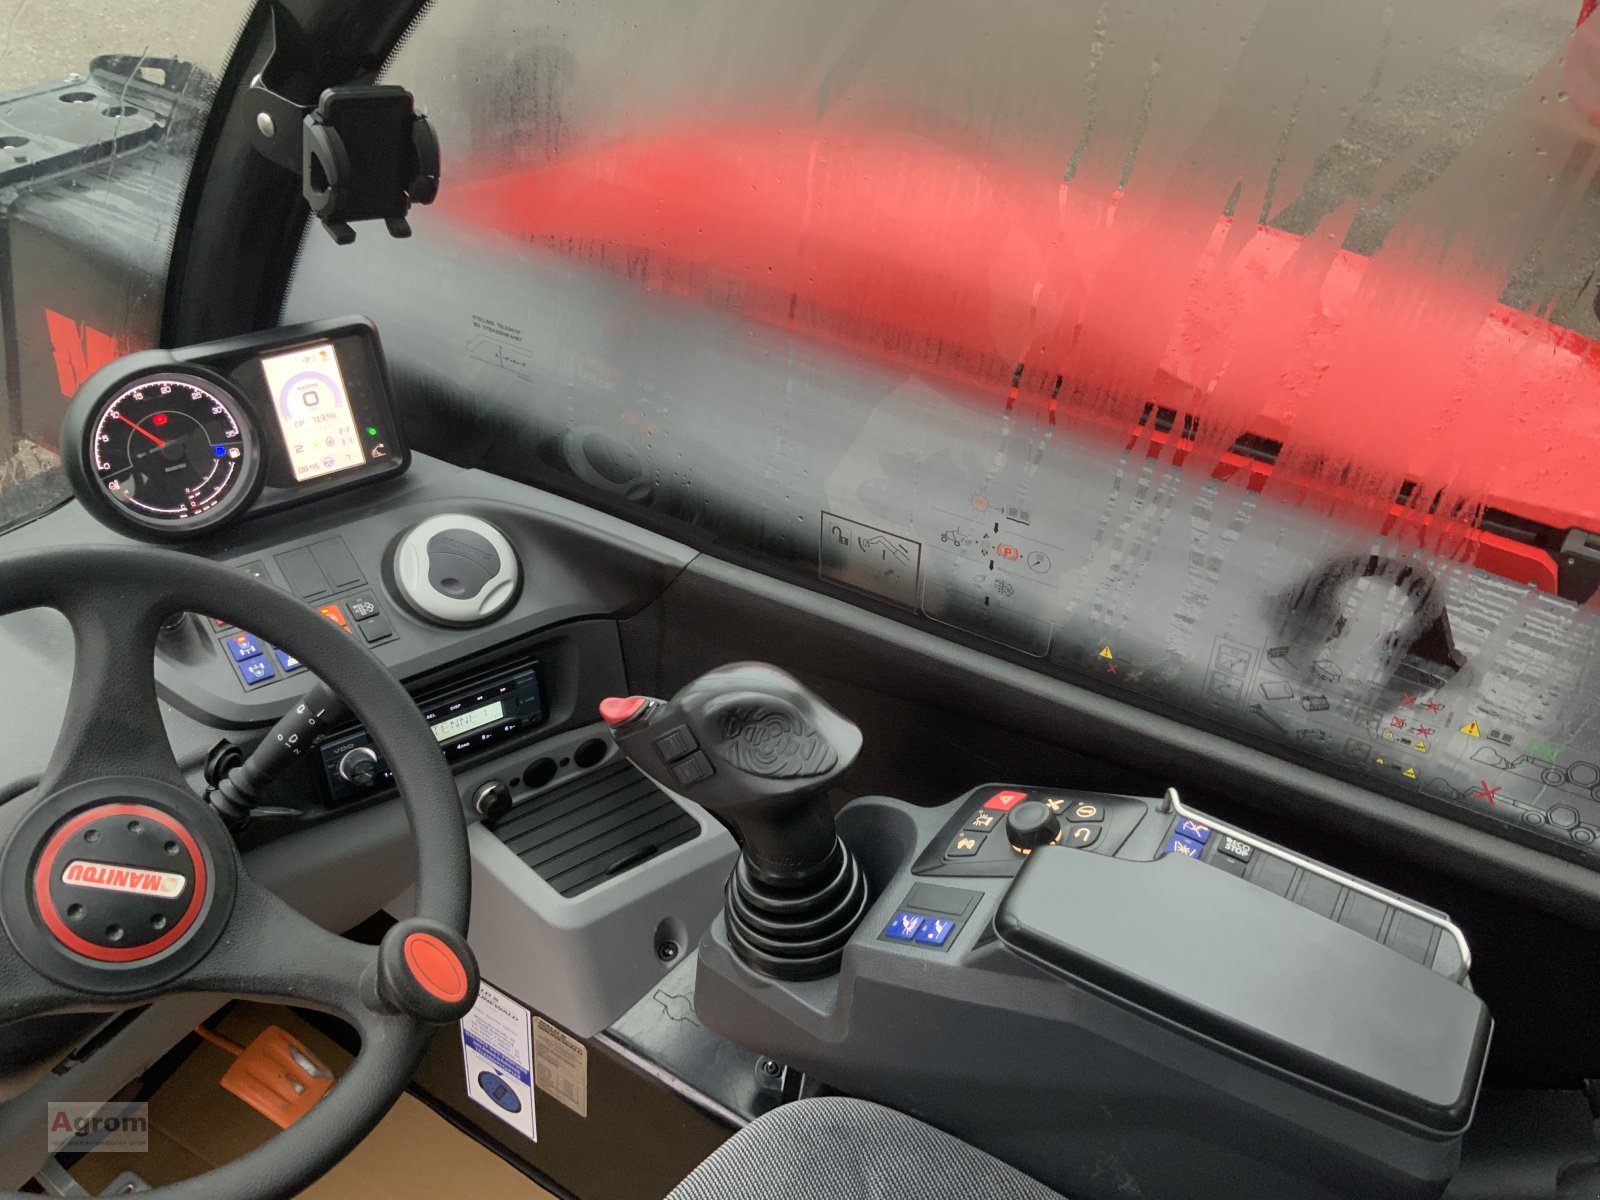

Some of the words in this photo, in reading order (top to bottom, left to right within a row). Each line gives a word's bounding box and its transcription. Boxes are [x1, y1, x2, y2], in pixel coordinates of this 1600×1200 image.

[161, 386, 171, 394] 20
[133, 392, 143, 400] 15
[191, 392, 202, 400] 25
[212, 407, 223, 415] 30
[226, 430, 236, 438] 35
[103, 462, 110, 470] 0
[333, 743, 354, 753] VDO
[1224, 843, 1249, 857] STOP
[68, 863, 162, 891] MANITOU
